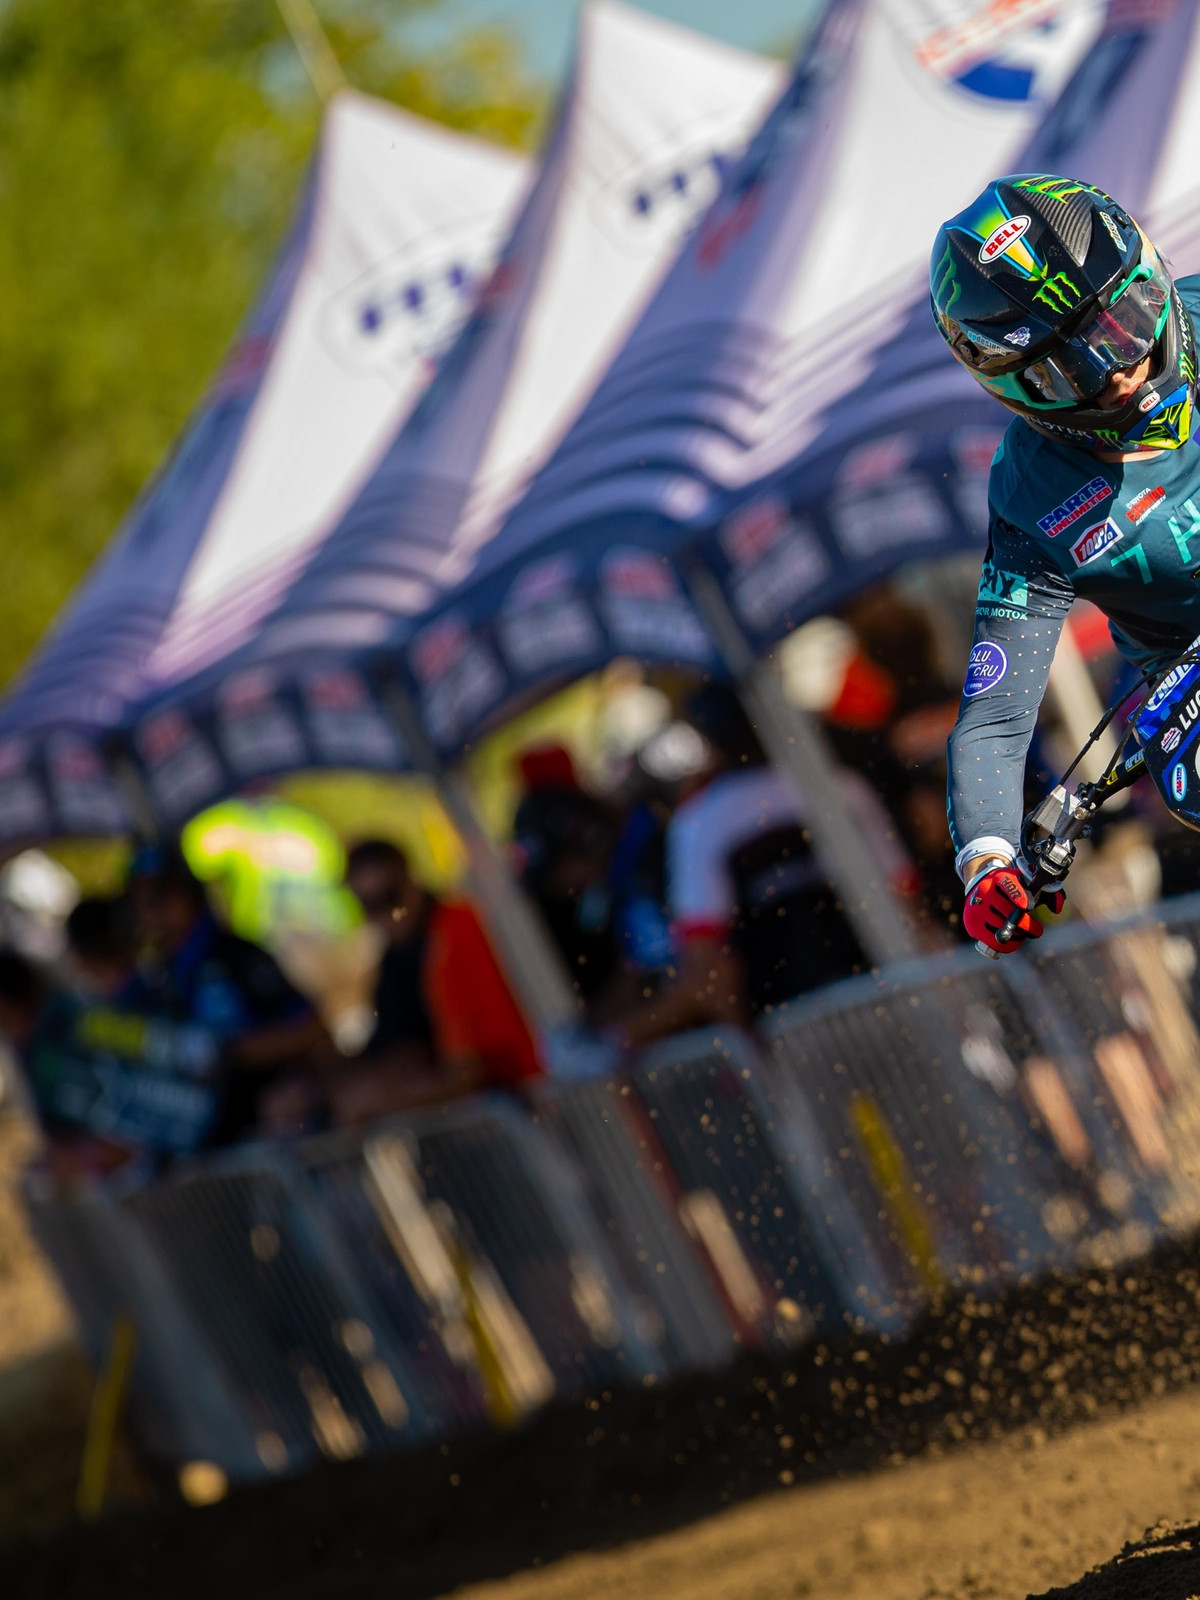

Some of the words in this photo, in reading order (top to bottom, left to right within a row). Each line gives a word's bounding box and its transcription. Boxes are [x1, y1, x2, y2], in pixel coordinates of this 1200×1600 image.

[985, 222, 1023, 257] BELL
[1141, 396, 1158, 410] BELL
[1037, 477, 1110, 531] PARTS
[1047, 487, 1112, 537] UNLIMITED
[1080, 523, 1115, 560] 100%
[991, 608, 1028, 620] MOTOX
